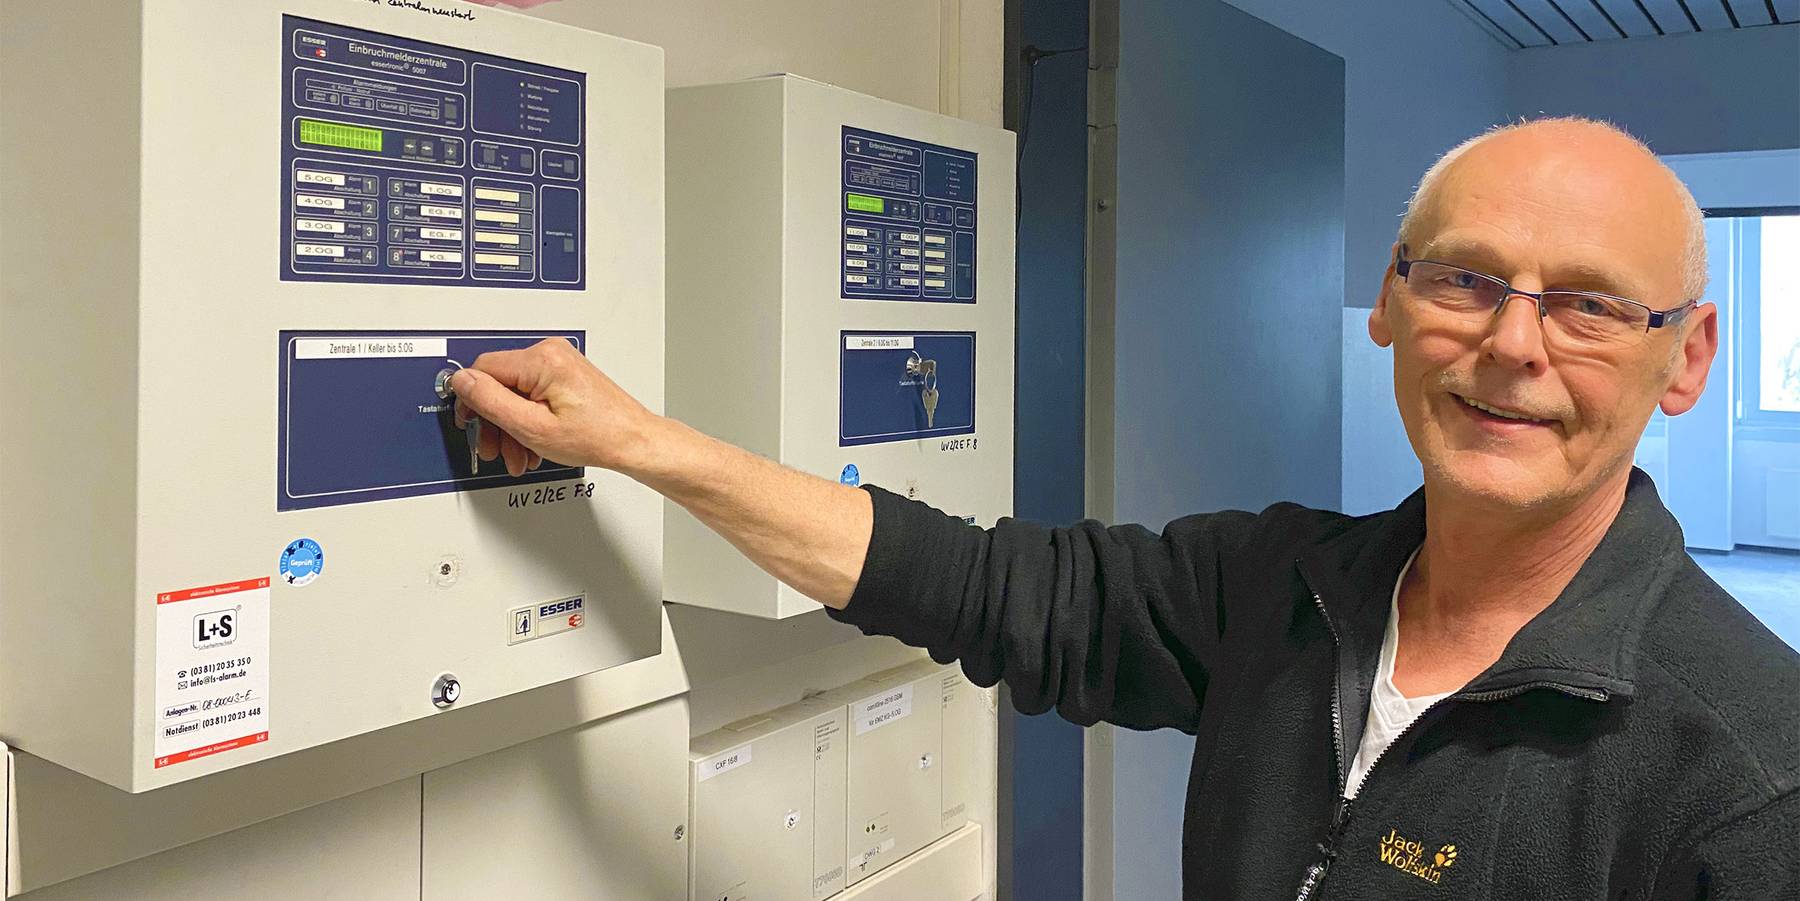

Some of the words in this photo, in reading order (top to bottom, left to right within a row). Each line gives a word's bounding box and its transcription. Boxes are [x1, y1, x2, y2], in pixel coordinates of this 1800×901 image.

[348, 42, 447, 69] Einbruchmelderzentrale
[304, 174, 333, 183] 5.OG
[366, 181, 373, 190] 1
[393, 183, 400, 193] 5
[304, 198, 333, 206] 4.OG
[366, 203, 373, 213] 2
[393, 206, 400, 216] 6
[304, 221, 333, 230] 3.OG
[366, 227, 373, 237] 3
[393, 229, 400, 238] 7
[304, 246, 334, 255] 2.OG
[366, 250, 373, 260] 4
[393, 251, 400, 261] 8
[329, 343, 356, 354] Zentrale
[368, 343, 385, 353] Keller
[387, 343, 396, 353] bis
[508, 492, 530, 508] UV
[290, 559, 313, 568] Geprüft
[540, 598, 582, 617] ESSER
[199, 614, 232, 642] L+S
[190, 669, 247, 688] info@ls-alarm.de
[165, 722, 199, 737] Notdienst
[1381, 829, 1423, 859] Jack
[1379, 842, 1442, 884] Wolfskin
